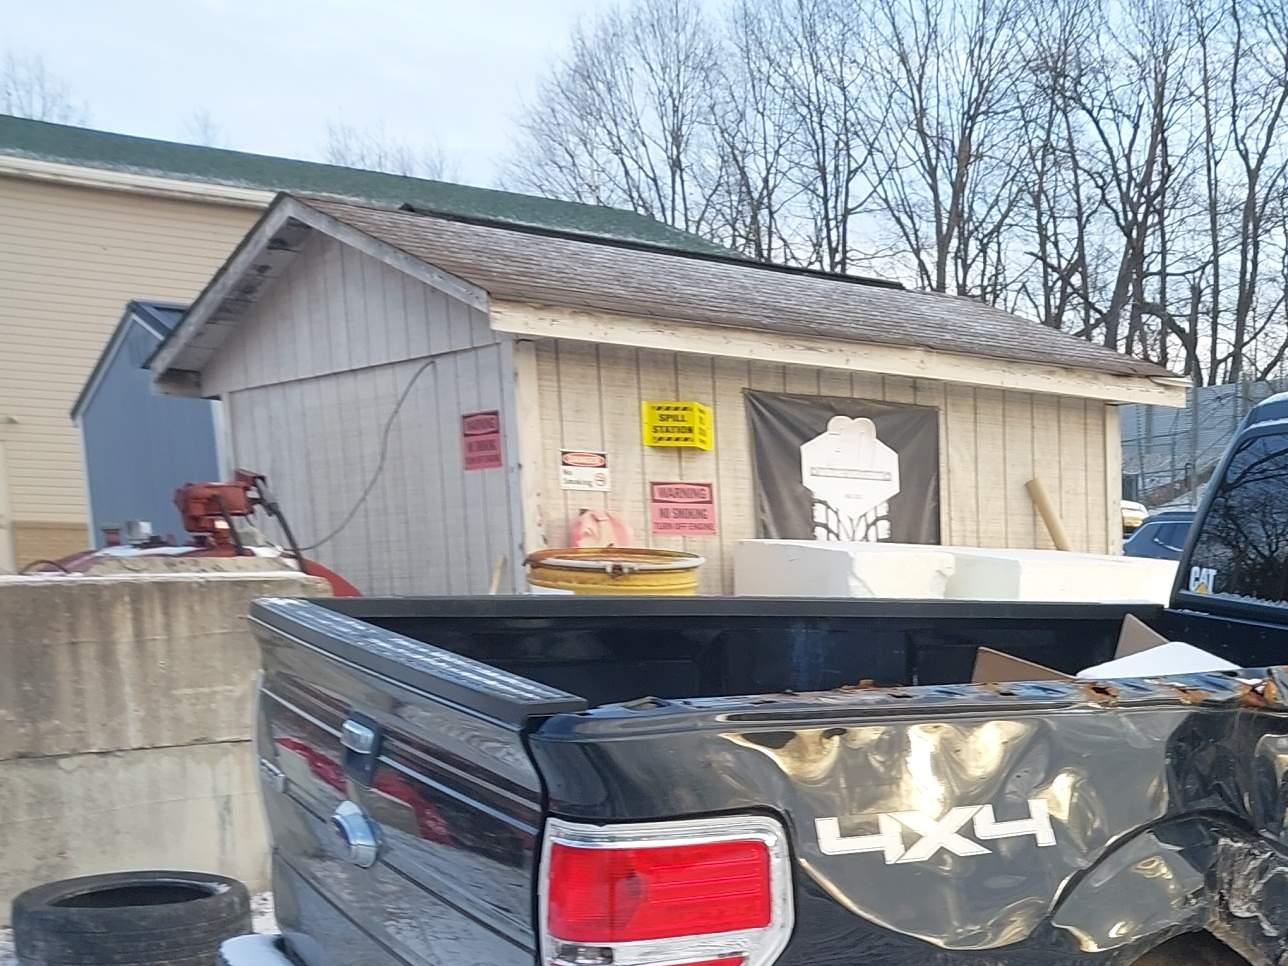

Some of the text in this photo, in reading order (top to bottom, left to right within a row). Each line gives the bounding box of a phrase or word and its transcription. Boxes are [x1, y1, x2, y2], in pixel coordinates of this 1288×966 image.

[658, 414, 688, 422] SPILL
[652, 426, 692, 434] STATION
[657, 487, 707, 499] WARNING
[659, 507, 707, 520] NO SMOKING
[675, 522, 688, 530] OFF
[1189, 566, 1217, 594] CAT
